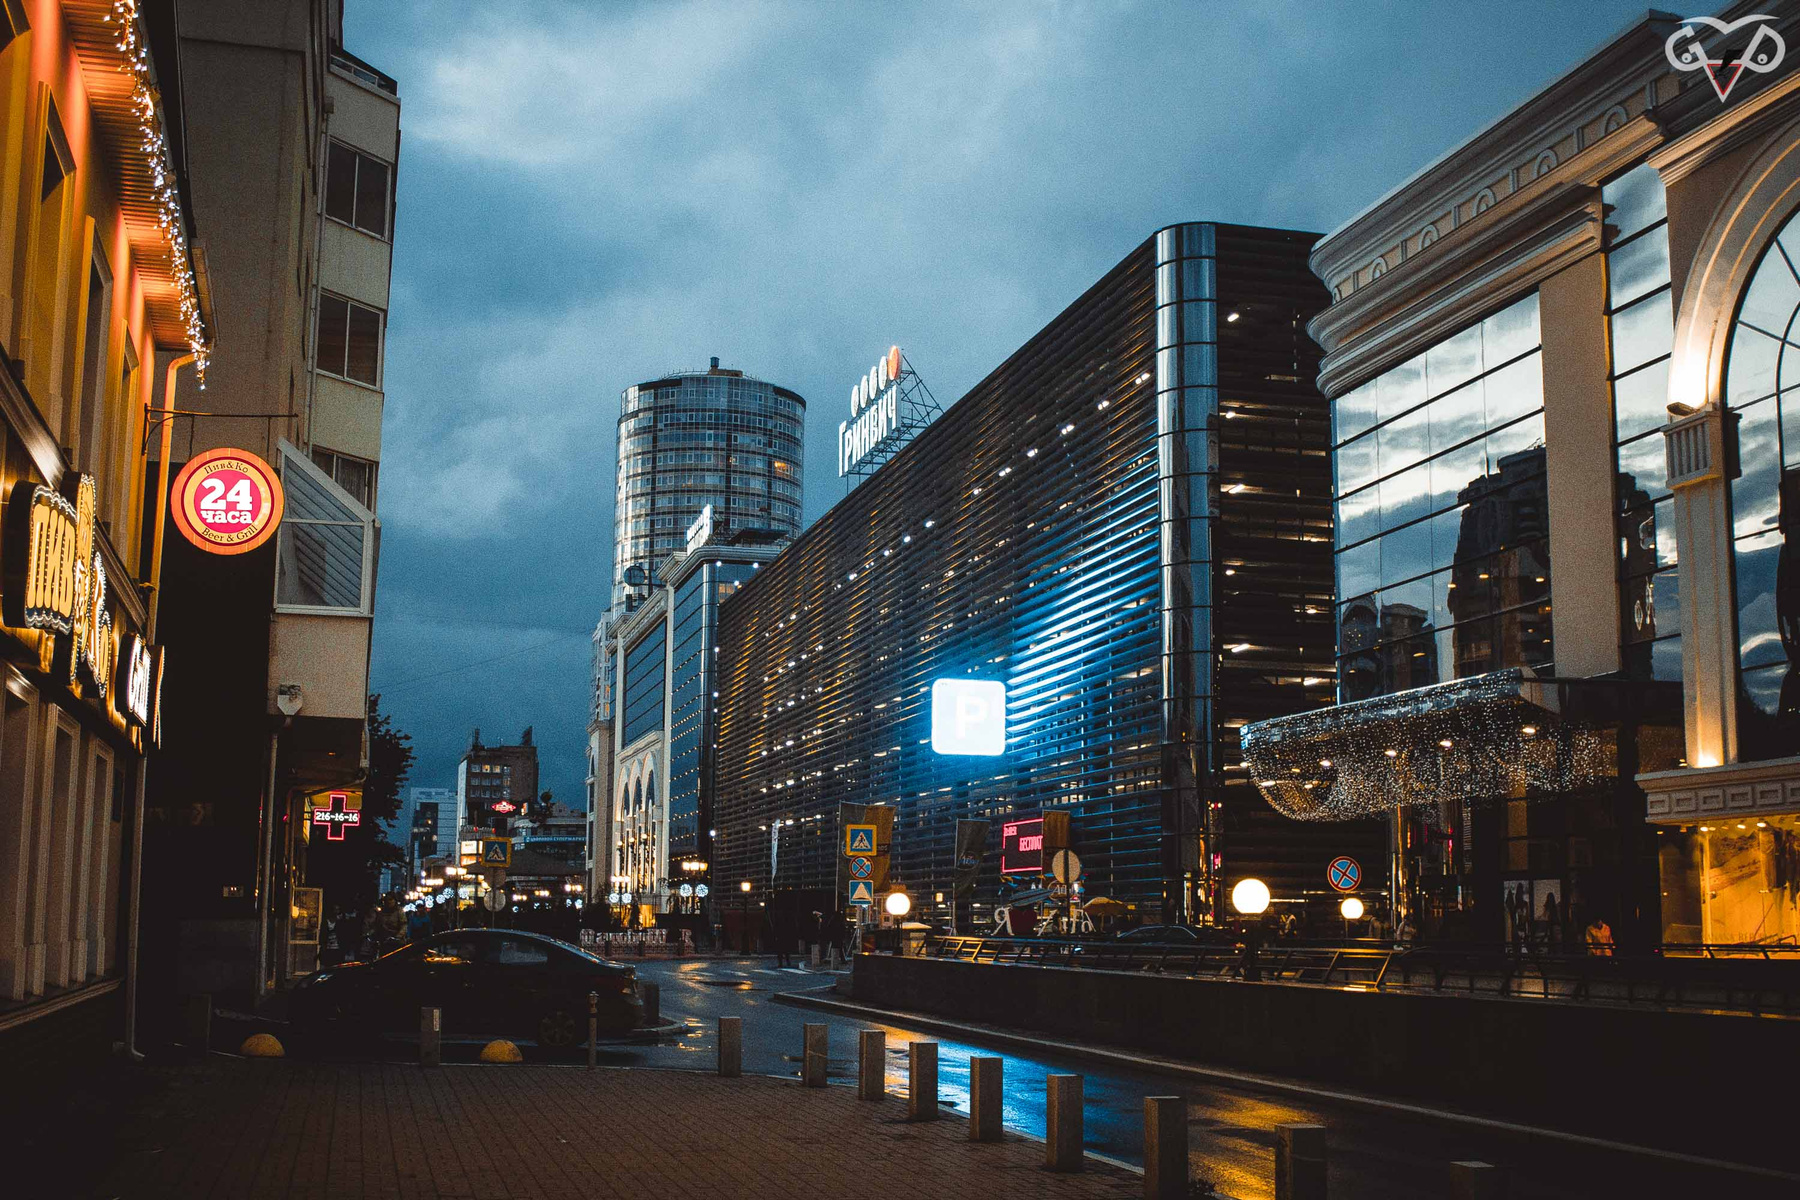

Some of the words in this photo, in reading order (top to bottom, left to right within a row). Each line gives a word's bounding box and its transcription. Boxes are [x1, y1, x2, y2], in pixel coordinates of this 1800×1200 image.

[839, 385, 897, 478] ГРИНВИЧ
[204, 461, 249, 474] Пив&Ко
[200, 478, 253, 511] 24
[200, 510, 253, 524] часа
[201, 527, 225, 542] Beer
[236, 524, 258, 540] Grill
[26, 503, 76, 618] ПИВ
[316, 811, 359, 822] 216-16-16
